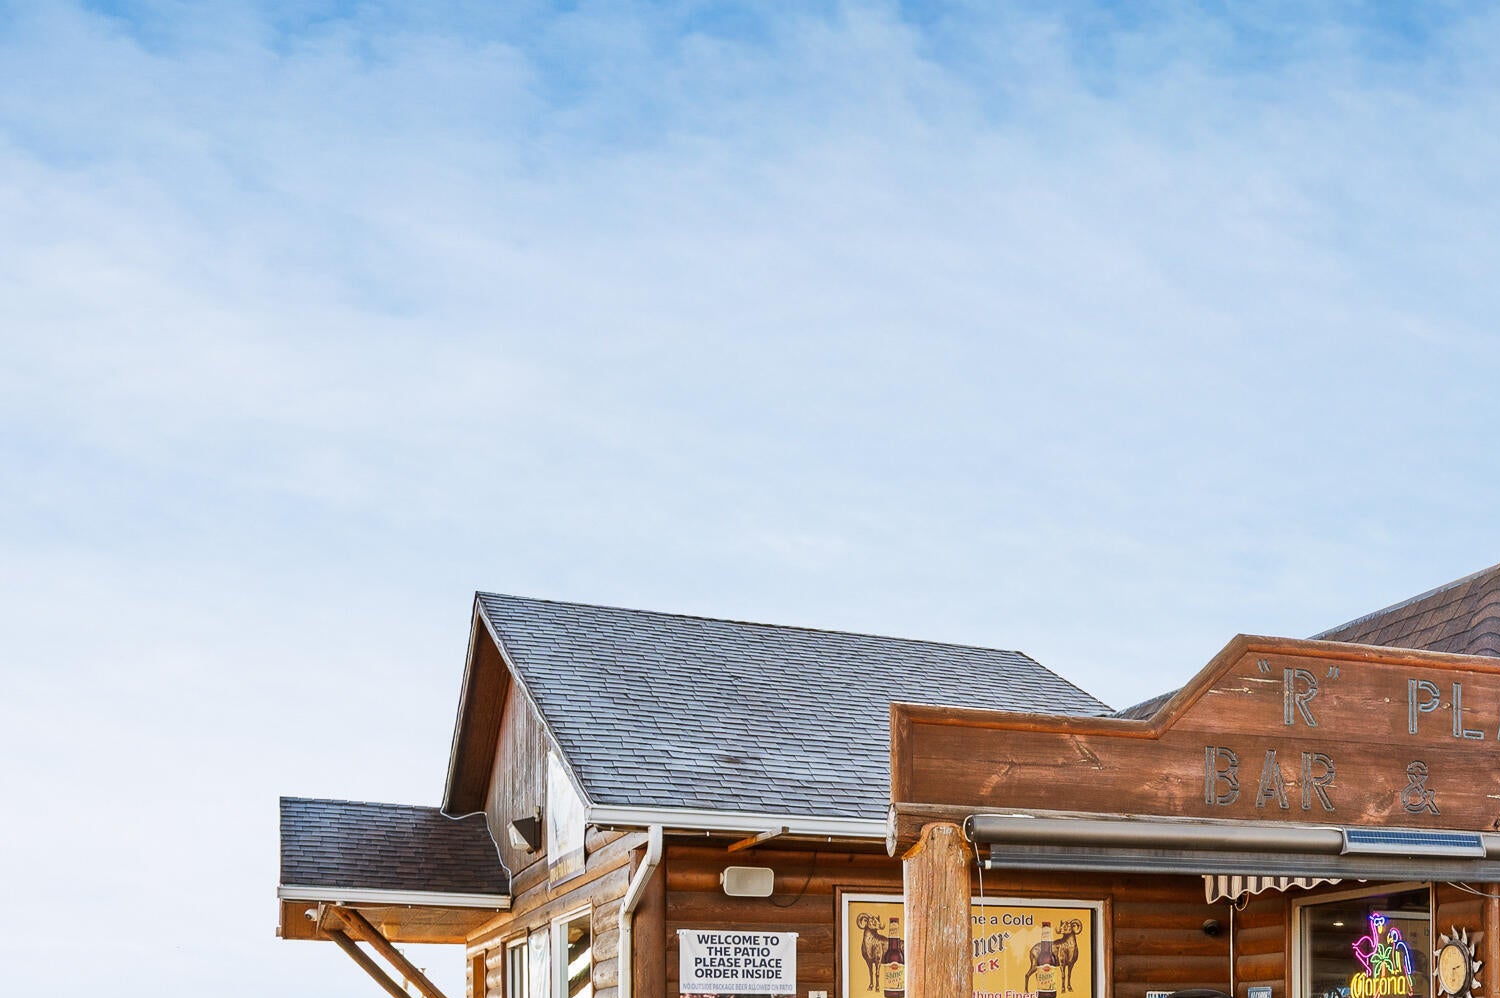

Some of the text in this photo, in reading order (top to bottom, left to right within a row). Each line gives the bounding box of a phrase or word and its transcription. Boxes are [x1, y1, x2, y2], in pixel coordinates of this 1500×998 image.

[1204, 746, 1336, 812] BAR
[1400, 760, 1440, 816] &
[990, 916, 998, 925] a
[1002, 914, 1033, 926] Cold
[697, 934, 780, 946] WELCOME TO
[973, 931, 1010, 958] ner
[707, 946, 771, 957] THE PATIO
[695, 957, 782, 968] PLEASE PLACE
[695, 968, 782, 979] ORDER INSIDE
[683, 983, 690, 991] NO
[735, 983, 748, 991] BEER
